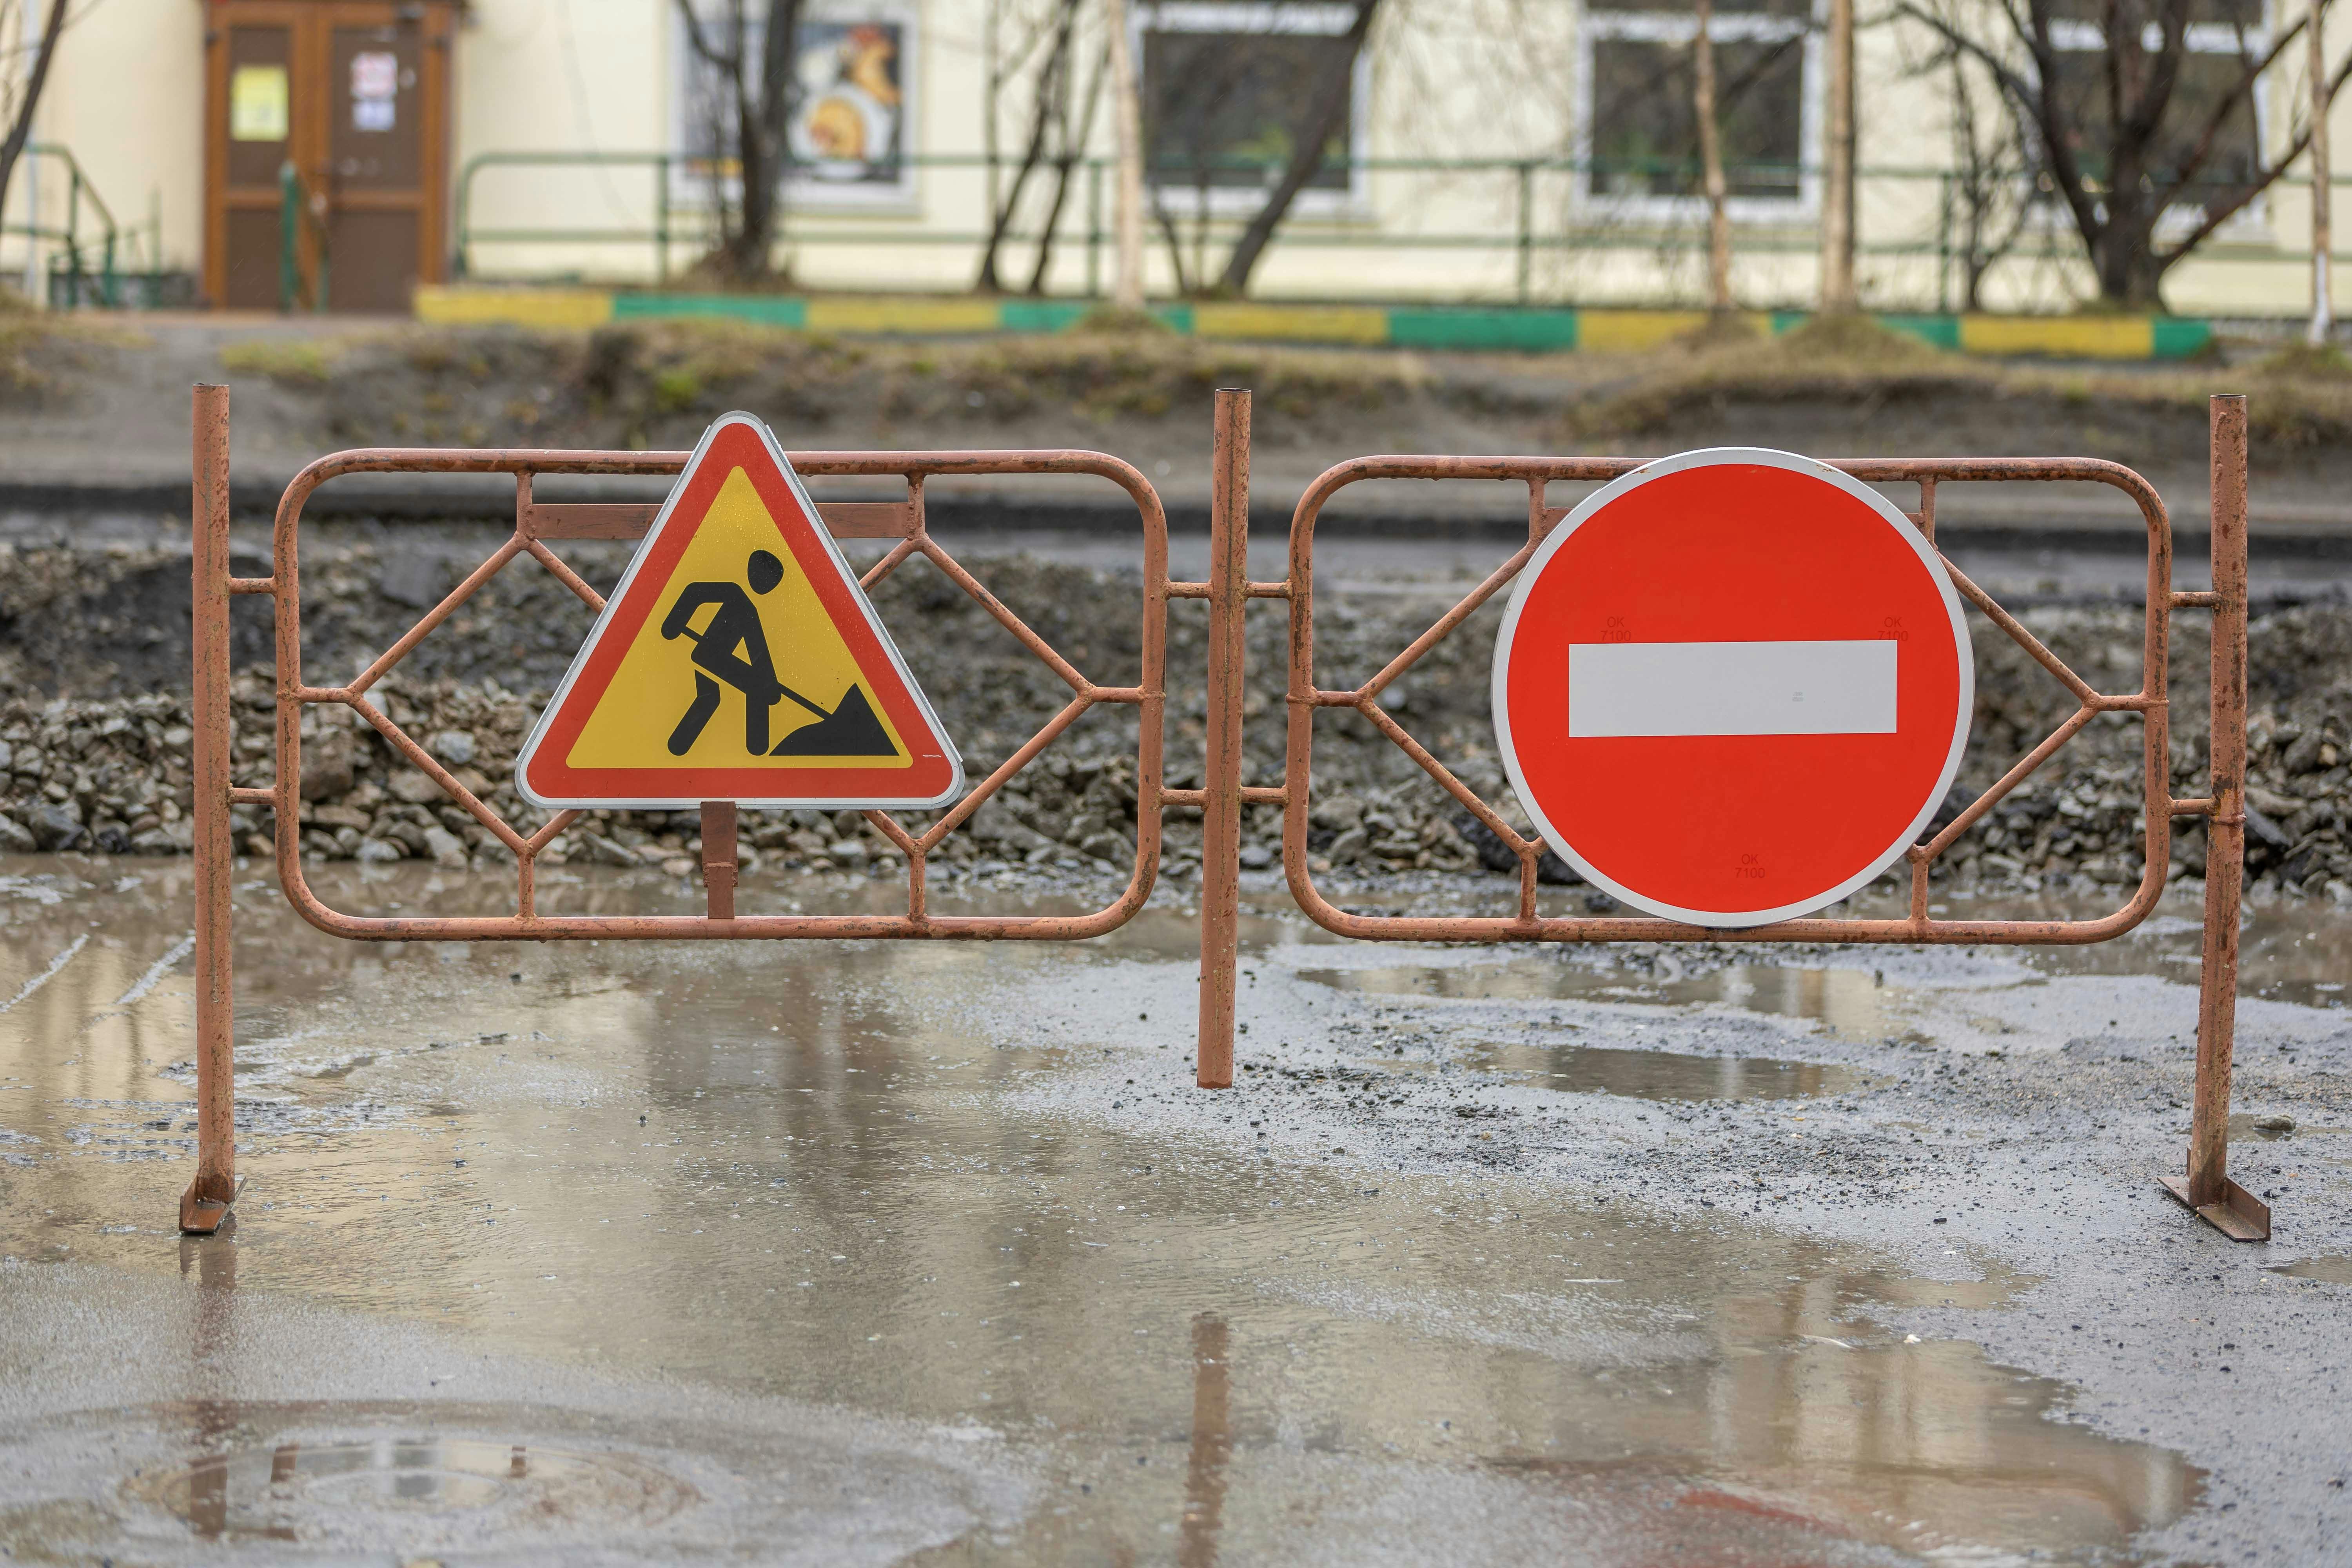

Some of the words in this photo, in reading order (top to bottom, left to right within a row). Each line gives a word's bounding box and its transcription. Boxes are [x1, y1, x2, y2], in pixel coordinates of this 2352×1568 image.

[1607, 616, 1625, 628] OK
[1884, 617, 1902, 628] OK
[1600, 630, 1631, 642] 7100
[1741, 853, 1759, 865] OK
[1734, 867, 1765, 878] 7100
